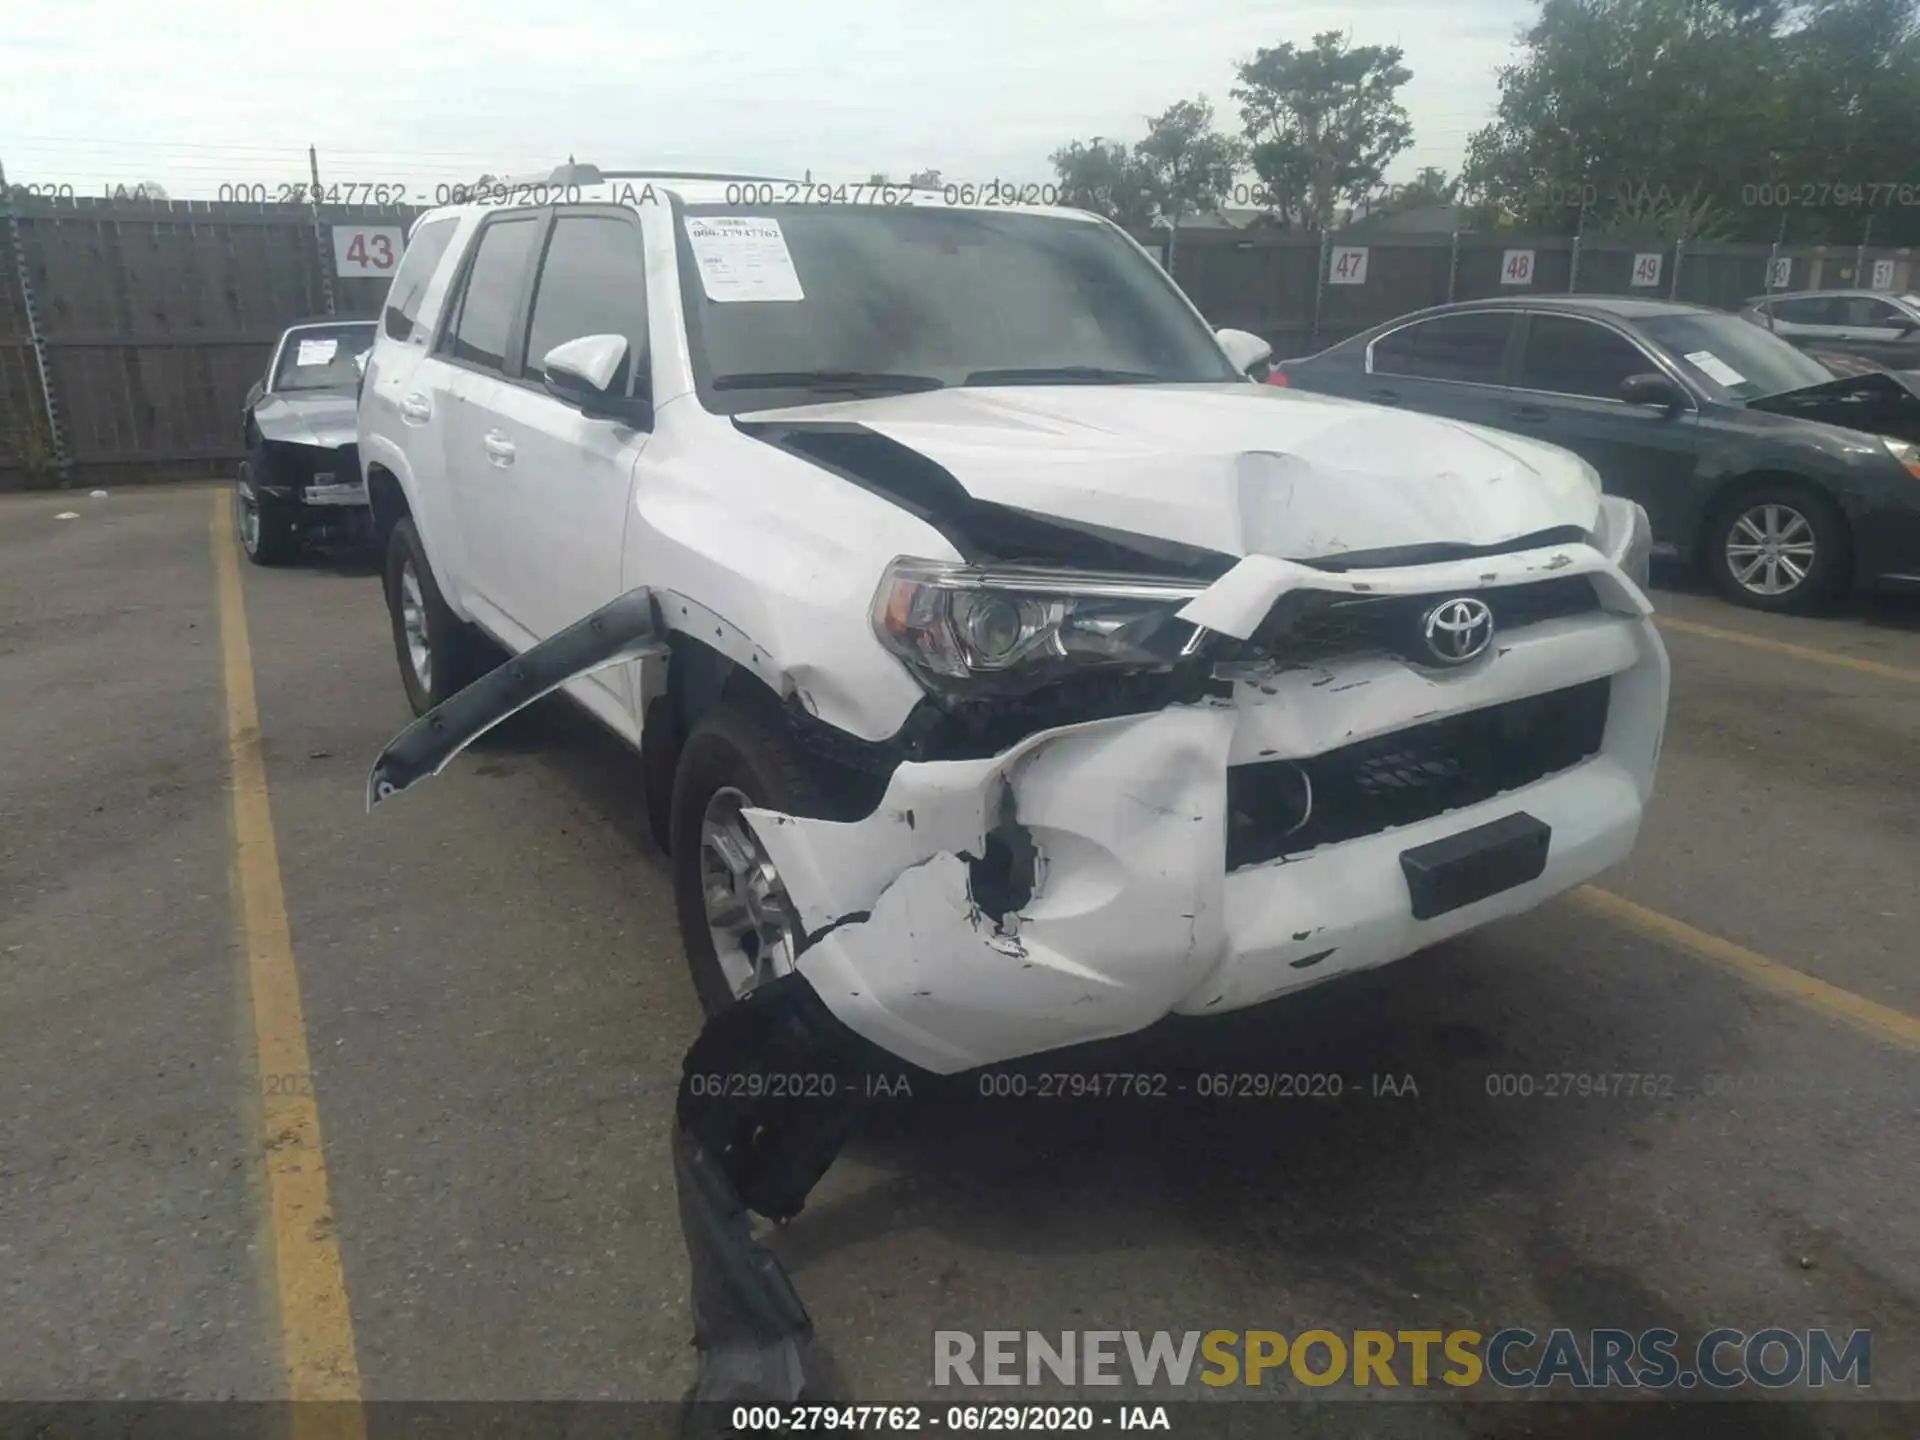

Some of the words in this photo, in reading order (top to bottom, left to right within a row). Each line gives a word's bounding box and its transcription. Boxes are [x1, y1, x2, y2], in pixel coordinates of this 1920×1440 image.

[345, 233, 395, 270] 43
[1336, 254, 1364, 277] 47
[1506, 255, 1531, 279] 48
[1636, 257, 1657, 282] 49
